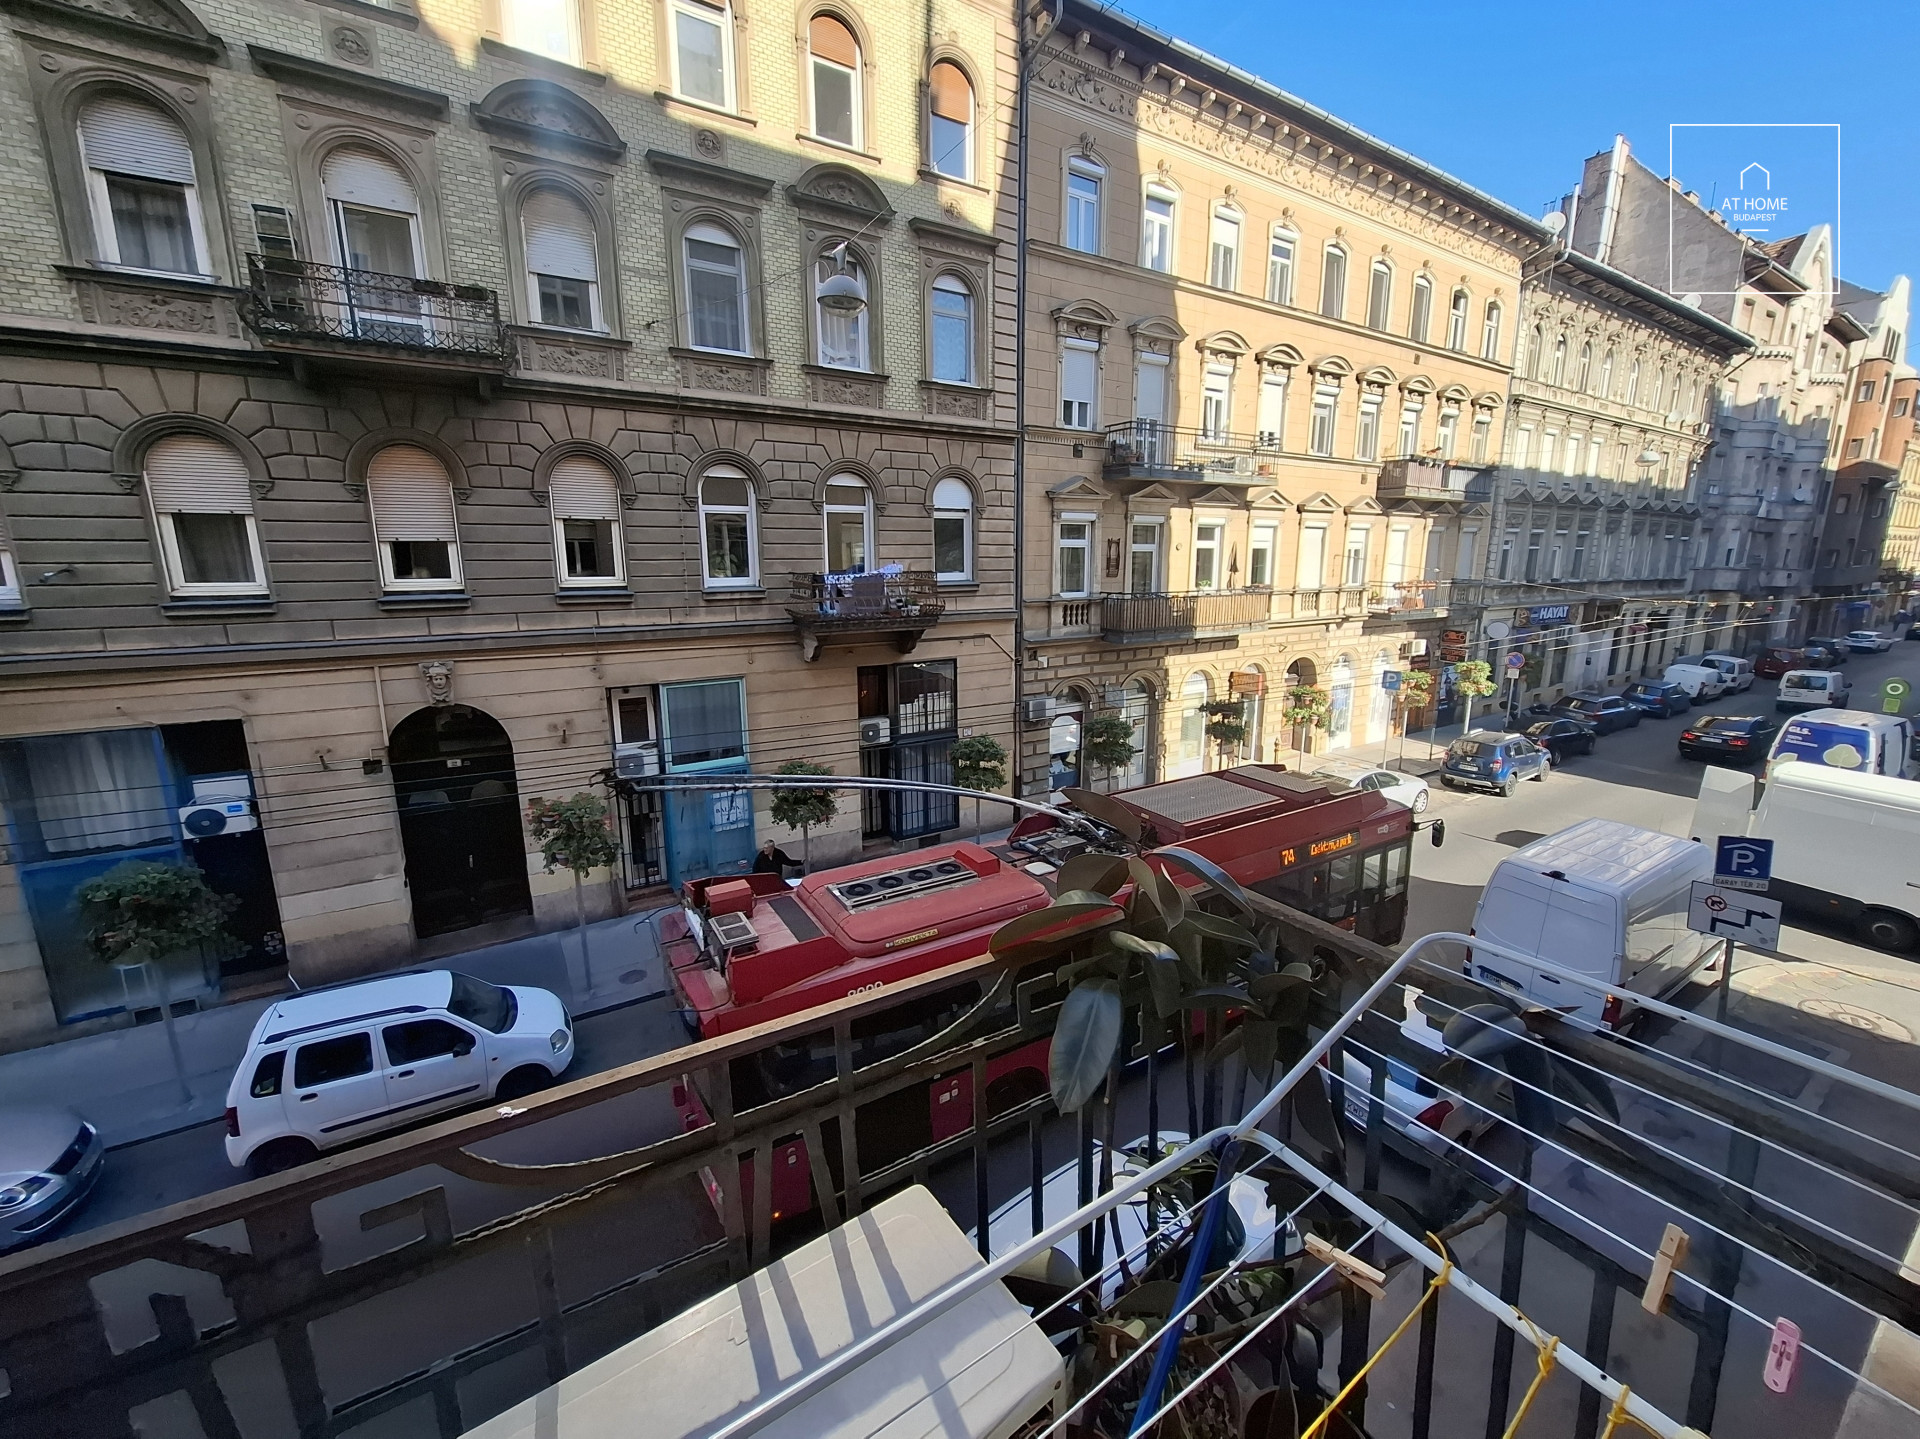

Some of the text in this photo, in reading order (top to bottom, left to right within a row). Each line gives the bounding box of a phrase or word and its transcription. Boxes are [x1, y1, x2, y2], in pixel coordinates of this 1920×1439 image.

[1540, 606, 1569, 619] HAYAT
[1388, 673, 1397, 685] P
[1282, 849, 1295, 865] 74
[1731, 850, 1755, 871] P
[1715, 878, 1738, 887] GARAY
